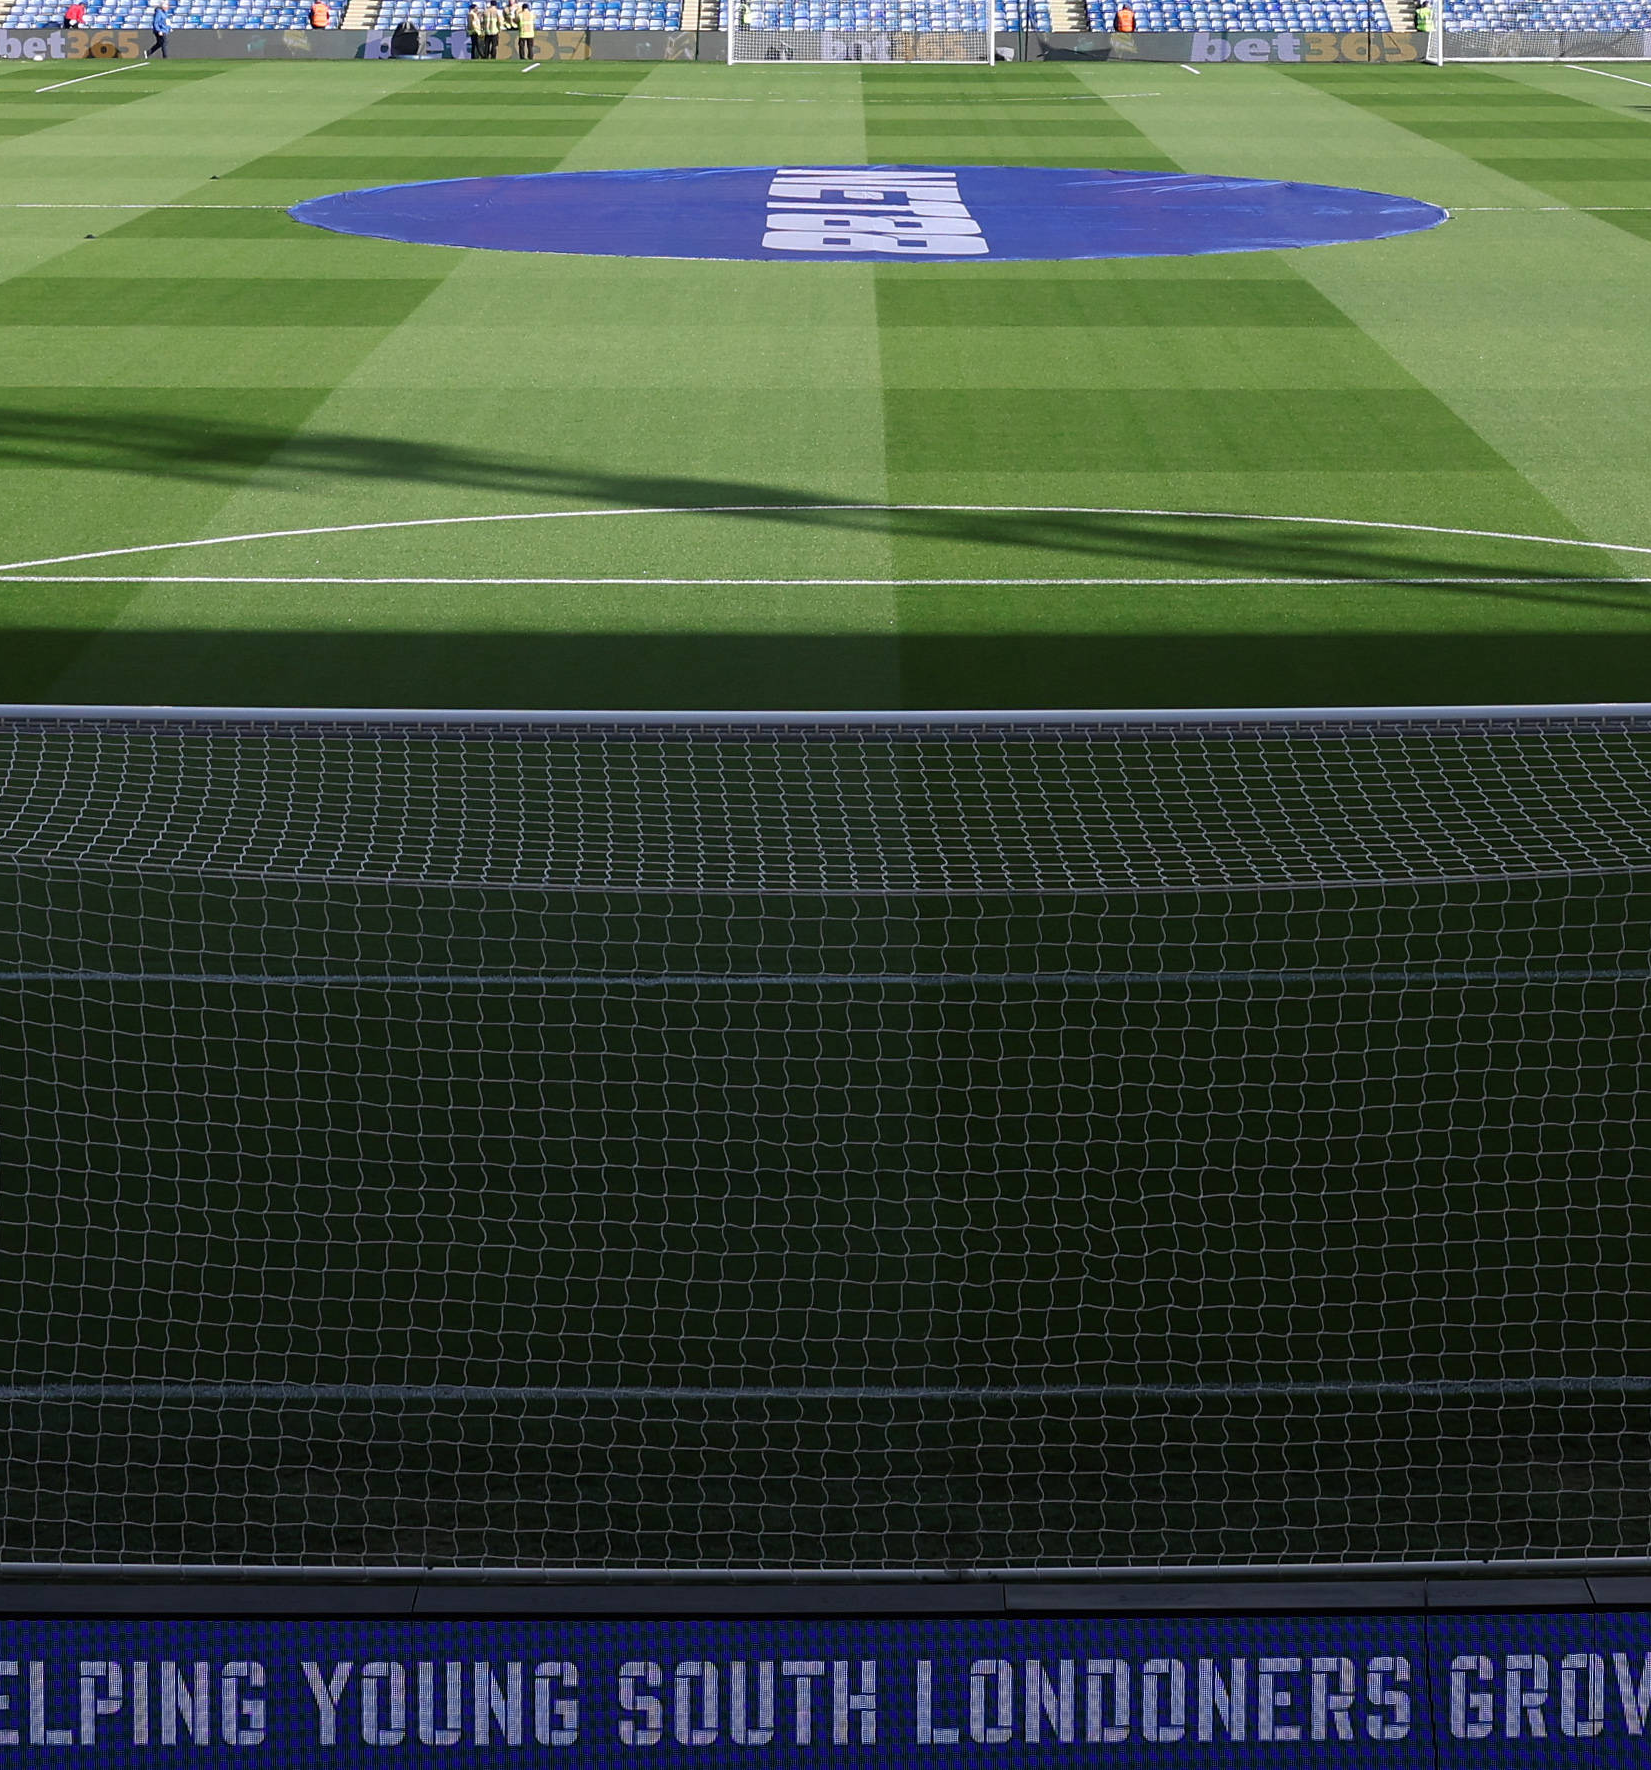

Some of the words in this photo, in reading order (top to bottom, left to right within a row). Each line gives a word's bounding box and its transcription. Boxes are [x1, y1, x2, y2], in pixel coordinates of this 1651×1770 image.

[1191, 32, 1418, 62] bet365
[300, 1660, 579, 1746] YOUNG
[618, 1660, 877, 1746] SOUTH
[916, 1656, 1412, 1745] LONDONERS
